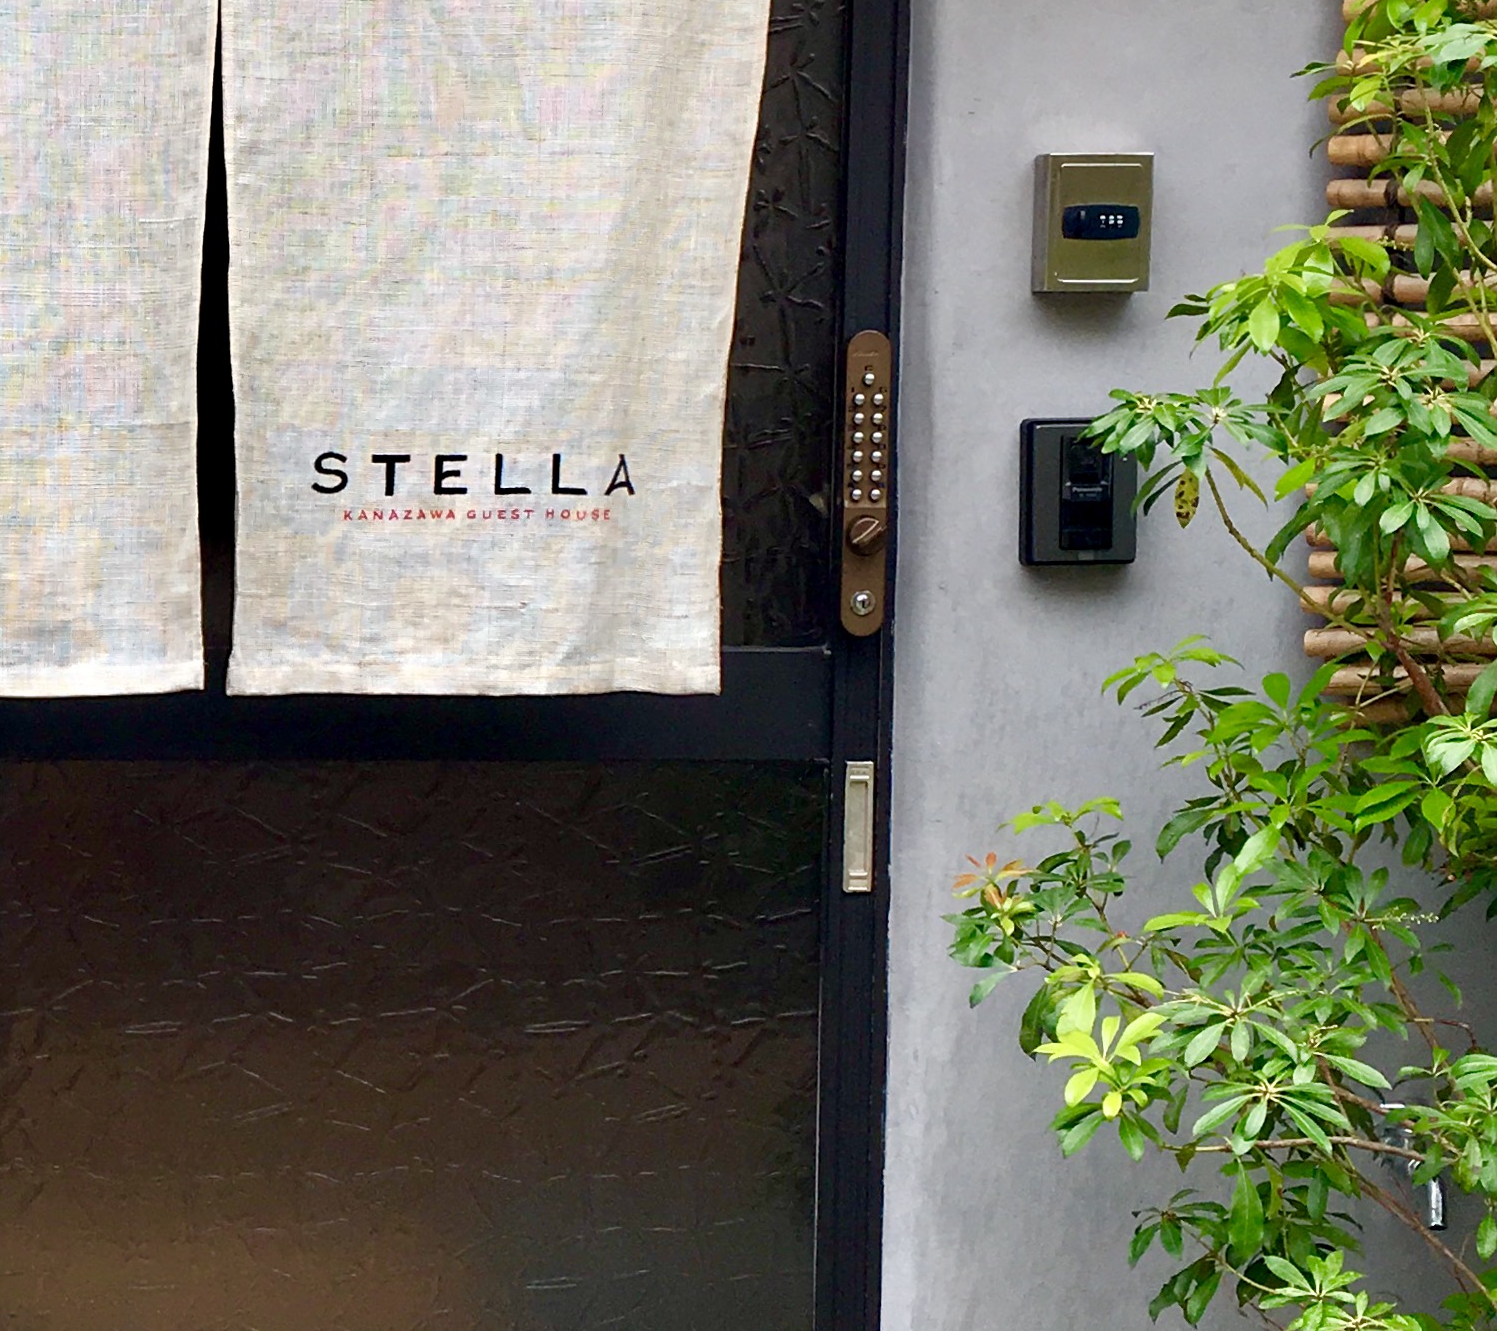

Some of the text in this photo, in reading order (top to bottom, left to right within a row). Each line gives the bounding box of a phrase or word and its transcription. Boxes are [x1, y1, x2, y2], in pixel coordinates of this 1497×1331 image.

[310, 451, 636, 497] STELLA
[342, 508, 611, 522] KANAZAWA GUEST HOUSE
